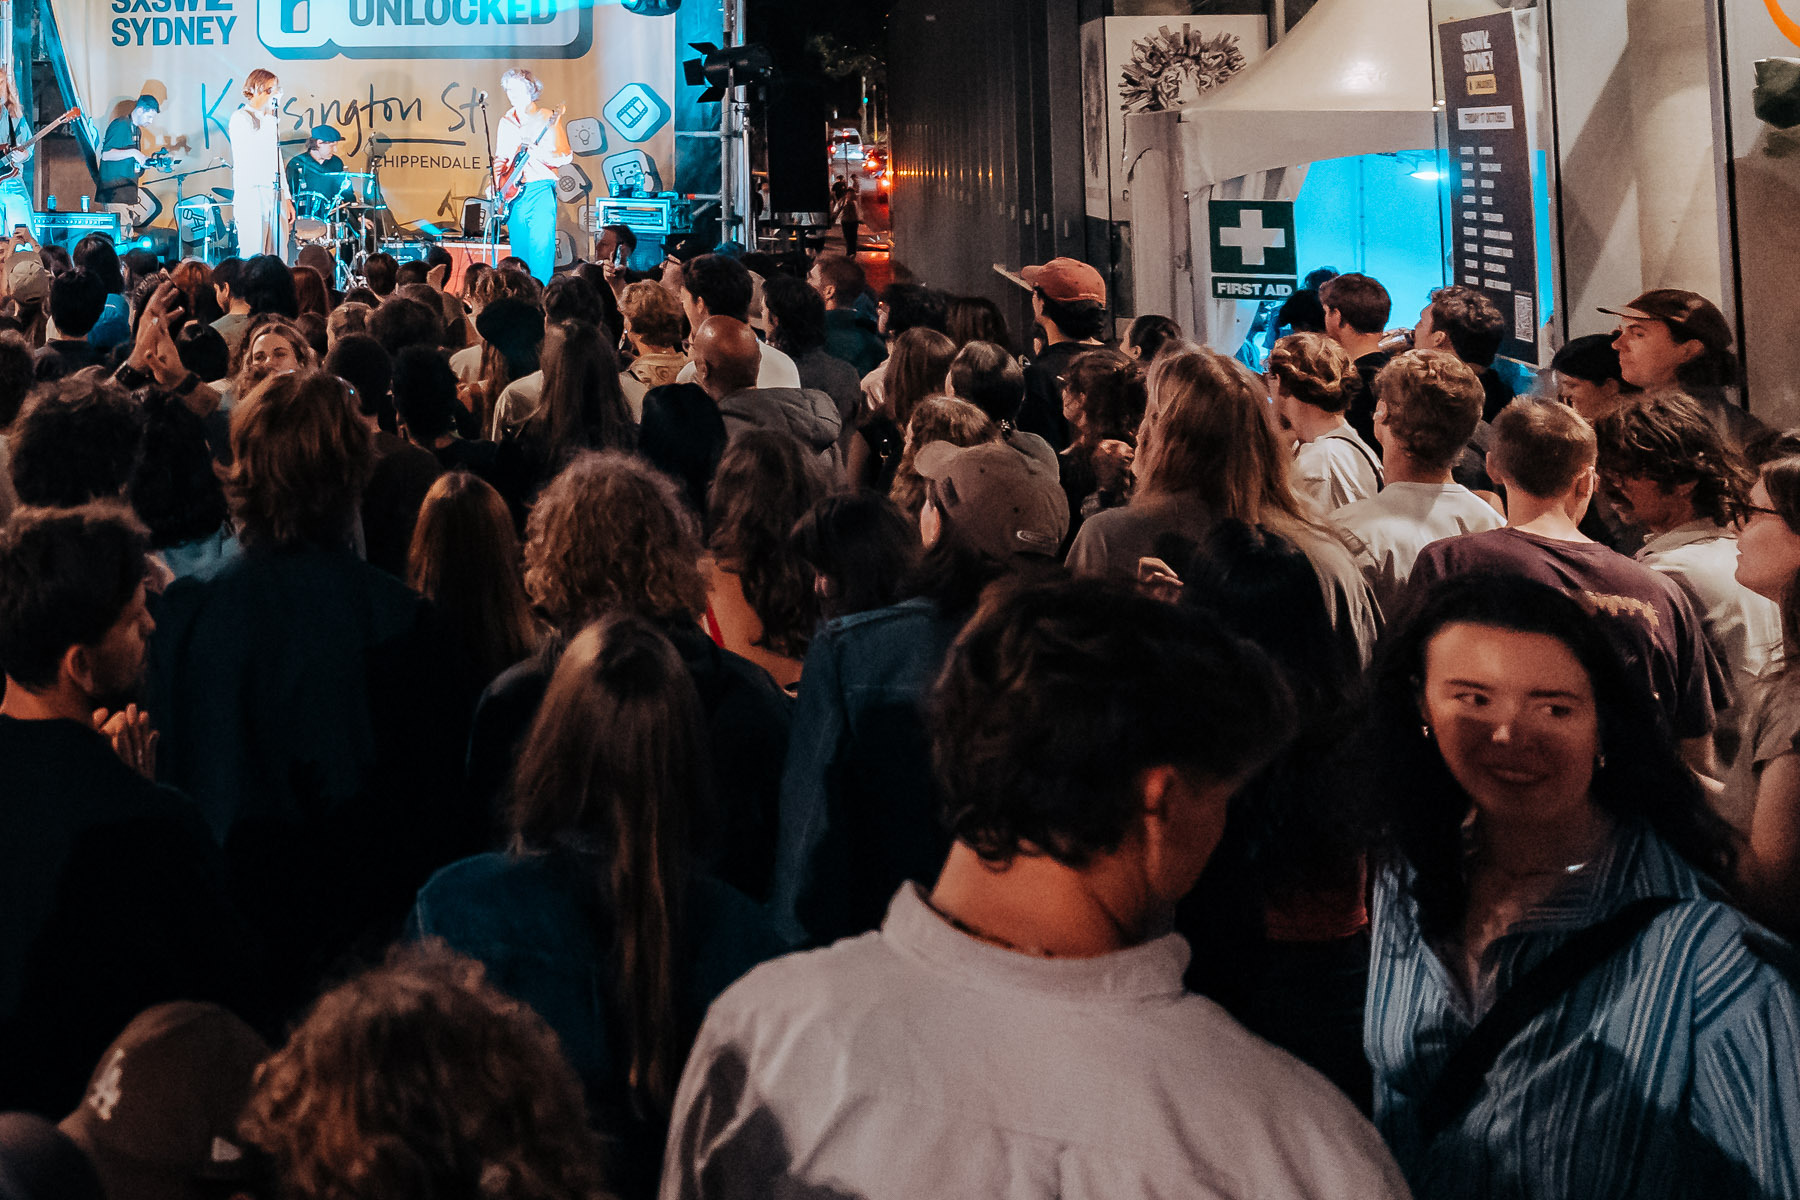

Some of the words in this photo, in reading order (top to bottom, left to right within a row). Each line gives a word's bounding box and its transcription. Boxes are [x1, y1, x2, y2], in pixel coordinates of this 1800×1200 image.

[111, 15, 238, 47] SYDNEY
[201, 78, 422, 157] Ksington
[372, 155, 481, 169] CHIPPENDALE
[1217, 282, 1262, 296] FIRST
[1264, 283, 1293, 296] AID
